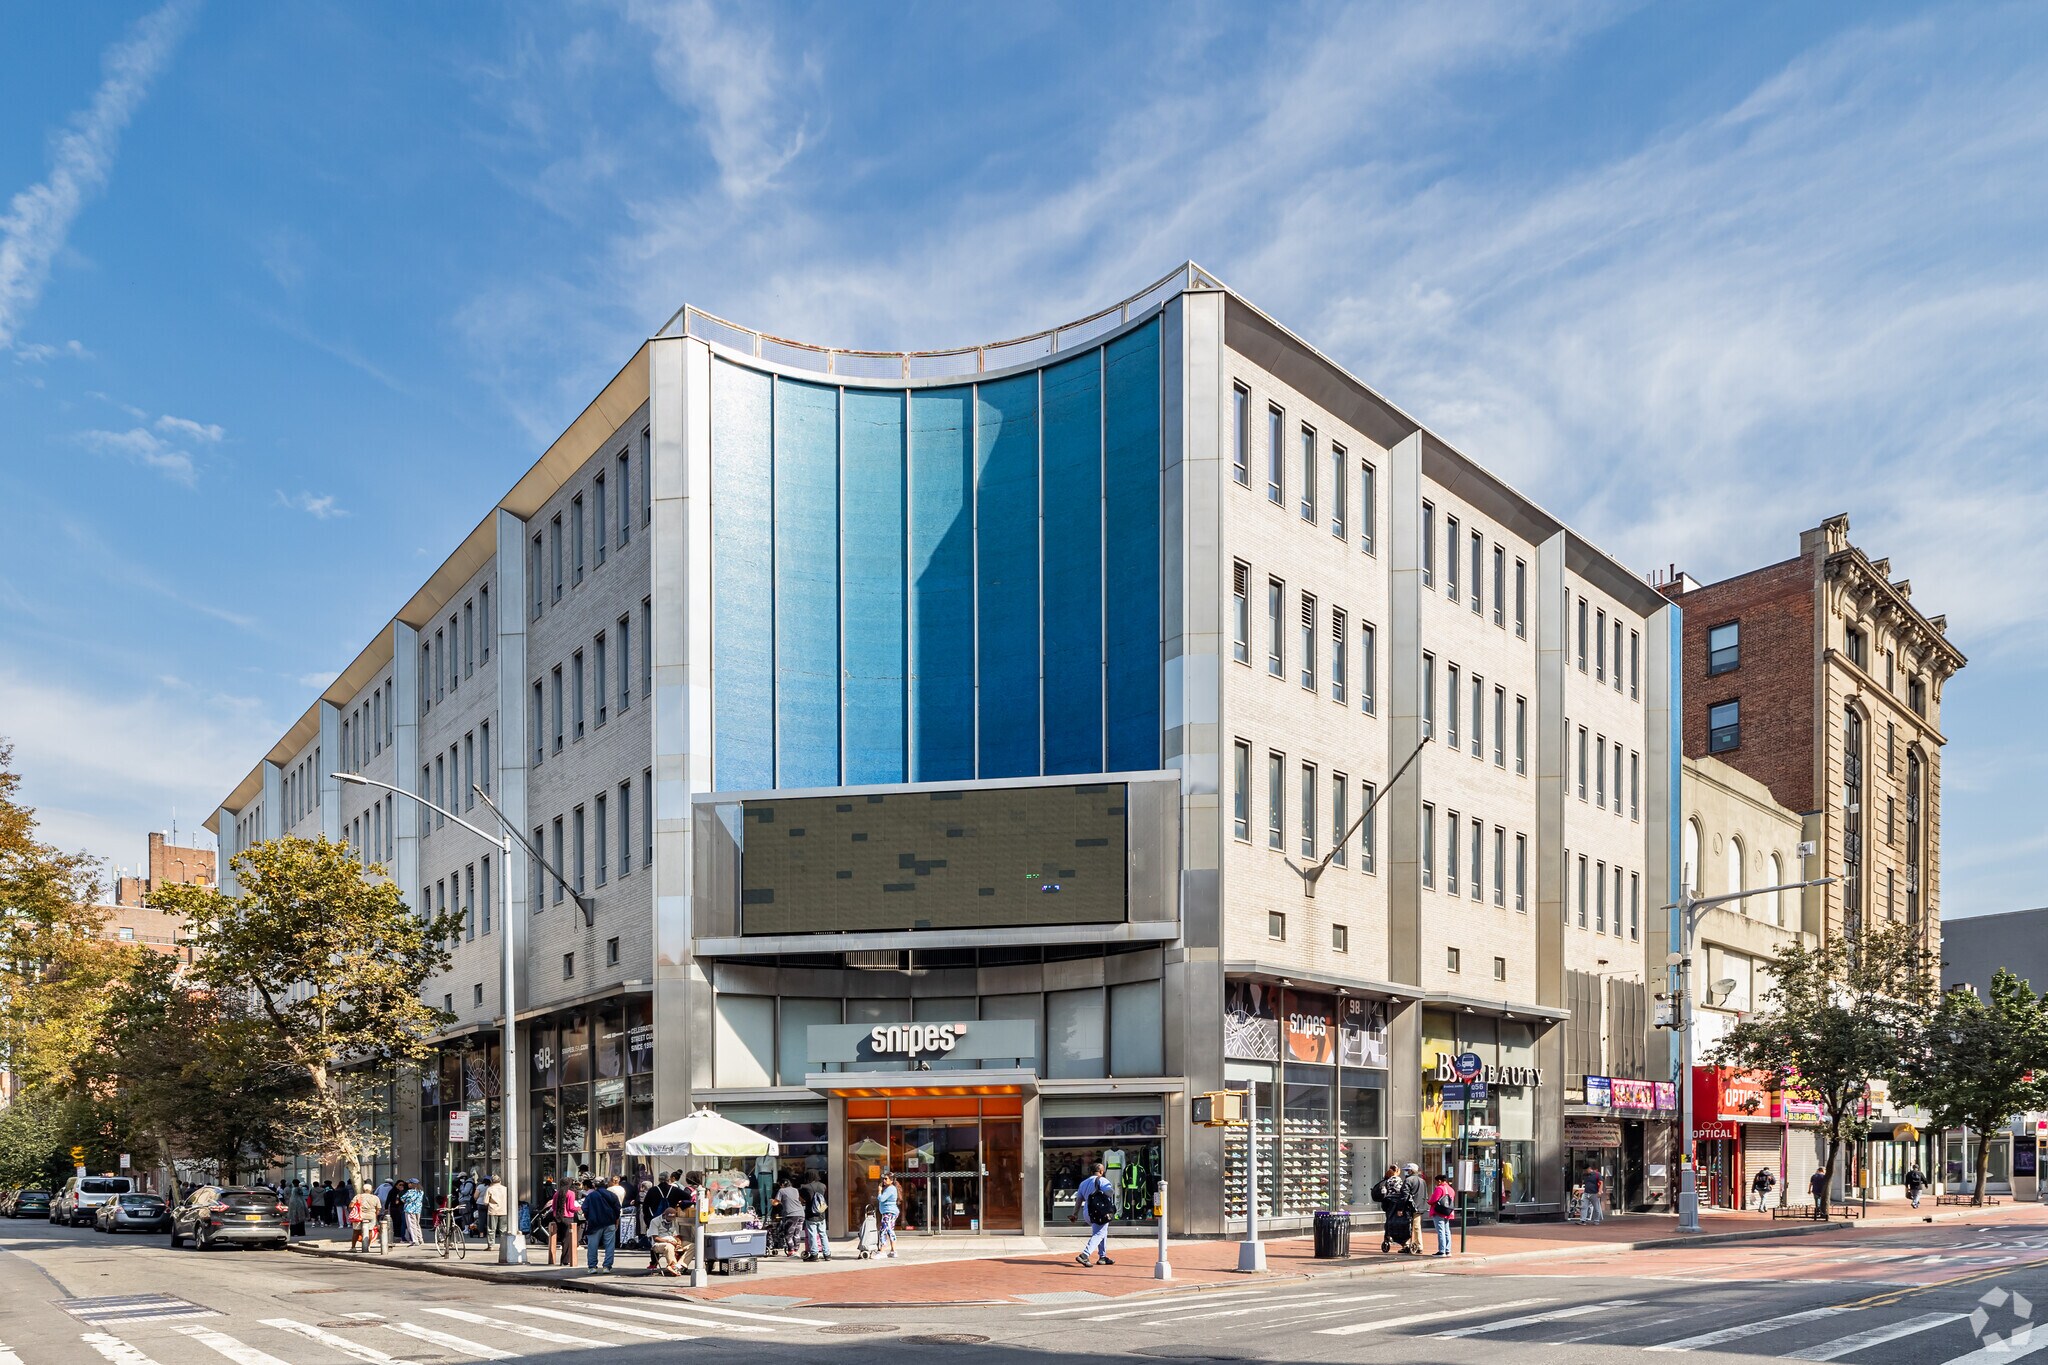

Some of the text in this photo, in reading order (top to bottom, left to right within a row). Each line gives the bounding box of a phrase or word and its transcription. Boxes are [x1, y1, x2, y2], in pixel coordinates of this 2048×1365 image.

[631, 1025, 654, 1035] CELEBRATI
[1290, 1013, 1326, 1039] snipes
[871, 1024, 956, 1058] snipes
[1725, 1088, 1765, 1108] OPTIL
[1692, 1129, 1732, 1139] OPTICAL
